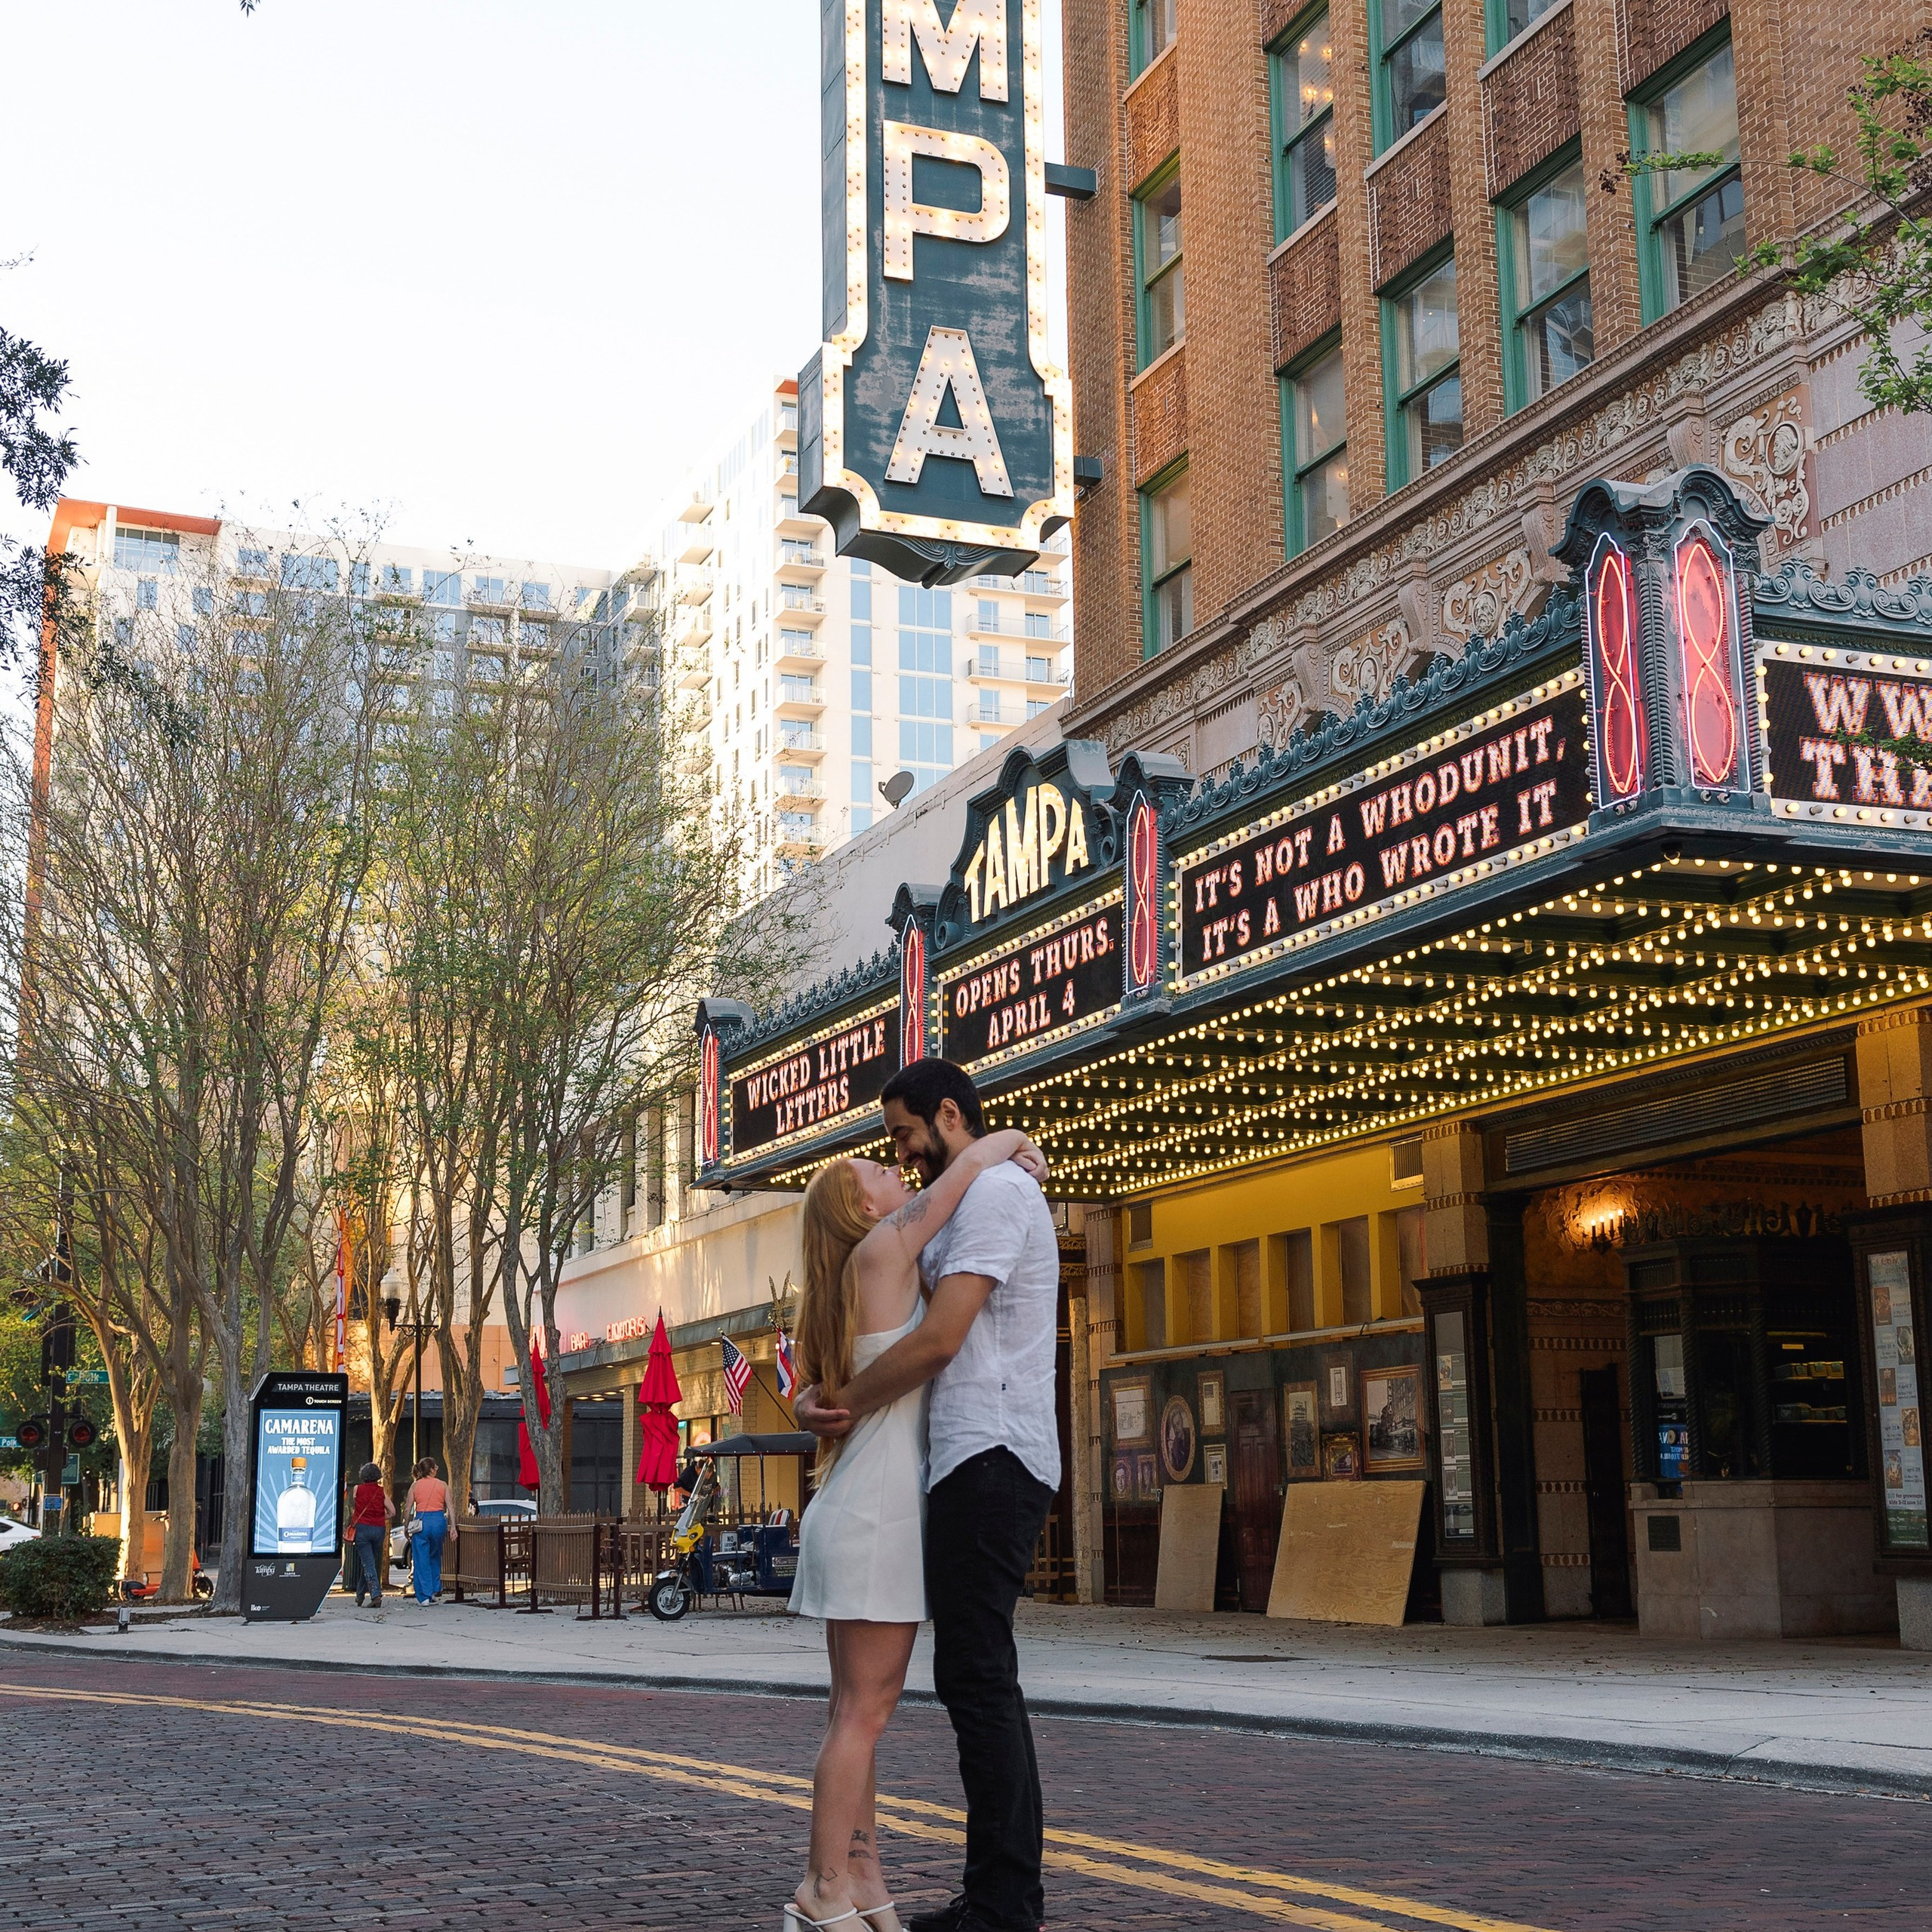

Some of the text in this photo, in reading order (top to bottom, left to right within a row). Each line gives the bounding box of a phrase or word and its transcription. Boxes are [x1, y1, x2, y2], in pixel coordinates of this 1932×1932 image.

[1194, 715, 1565, 913] IT'S NOT A WHODUNIT,
[964, 783, 1091, 924] TAMPA
[1201, 778, 1557, 961] IT'S A WHO WROTE IT
[955, 917, 1115, 1019] OPENS THURS.
[986, 980, 1075, 1050] APRIL 4
[746, 1020, 886, 1112] WICKED LITTLE
[775, 1074, 850, 1136] LETTERS
[571, 1332, 588, 1351] BAR
[606, 1316, 646, 1343] LIQUORS
[265, 1419, 334, 1435] CAMARENA
[267, 1446, 330, 1455] AWARDED TEQUILA
[281, 1437, 316, 1446] THE MOST
